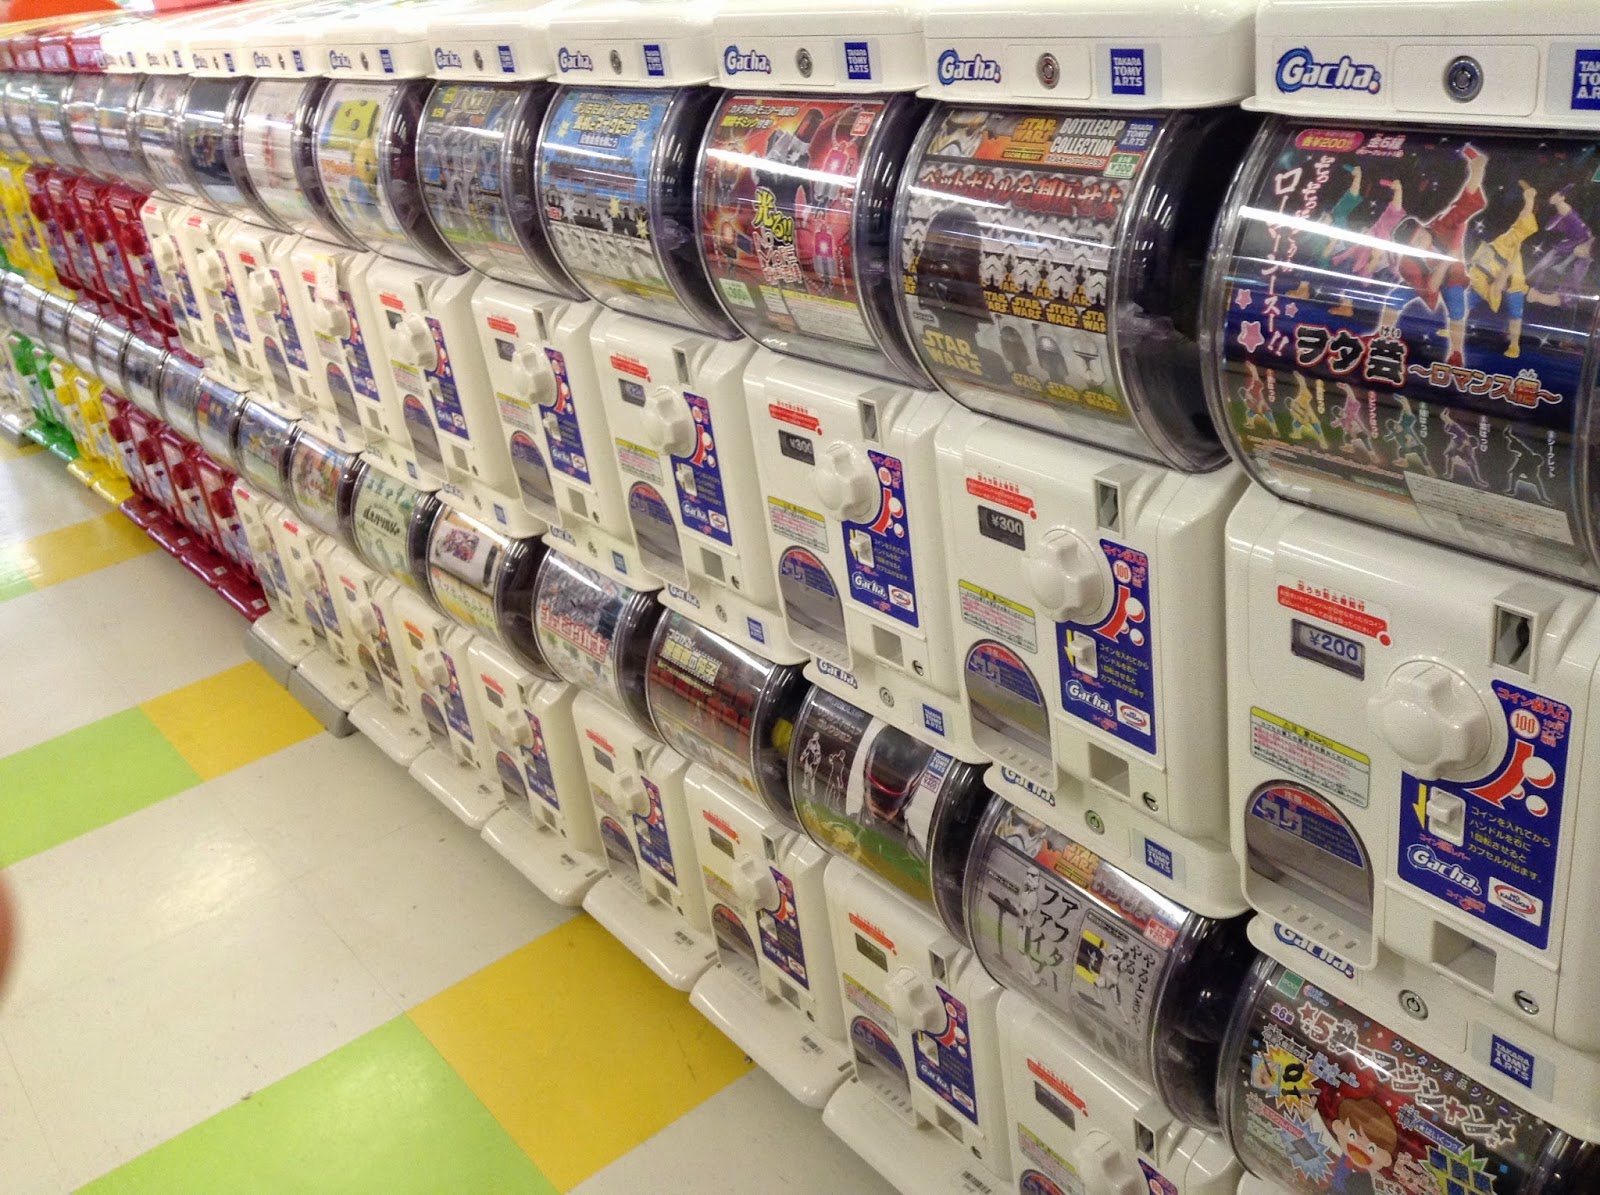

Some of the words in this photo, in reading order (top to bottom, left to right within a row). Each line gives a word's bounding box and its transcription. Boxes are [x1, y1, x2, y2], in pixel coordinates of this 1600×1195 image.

[937, 48, 1001, 87] Gacha
[1114, 57, 1142, 66] TAKARA
[1114, 66, 1142, 76] TOMY
[1276, 46, 1382, 95] Gacha
[1020, 118, 1056, 131] STAR
[1059, 118, 1126, 137] BOTTLECAP
[1126, 130, 1150, 138] TOMY
[1049, 136, 1117, 157] COLLECTION
[752, 187, 794, 245] 光る!!
[1012, 296, 1040, 310] STAR
[1012, 305, 1042, 320] WARS
[1046, 303, 1075, 317] STAR
[1046, 313, 1077, 327] WARS
[922, 329, 977, 360] STAR
[926, 345, 983, 376] WARS
[1294, 325, 1408, 388] ヲタ芸
[991, 513, 1023, 537] ¥300
[852, 571, 888, 600] Gacha
[1309, 630, 1358, 661] ¥200
[1065, 679, 1114, 717] Gacha
[1515, 713, 1536, 734] 100
[932, 756, 950, 767] TOMY
[1469, 818, 1532, 852] ハンドルを右に
[1471, 805, 1552, 848] コインを入れてから
[1147, 850, 1171, 867] TOMY
[1470, 831, 1527, 864] 1回転させると
[1406, 843, 1483, 896] Gacha
[1467, 843, 1542, 883] カプセルが出ます。
[1494, 1042, 1530, 1065] TAKARA
[1494, 1049, 1530, 1072] TOMY
